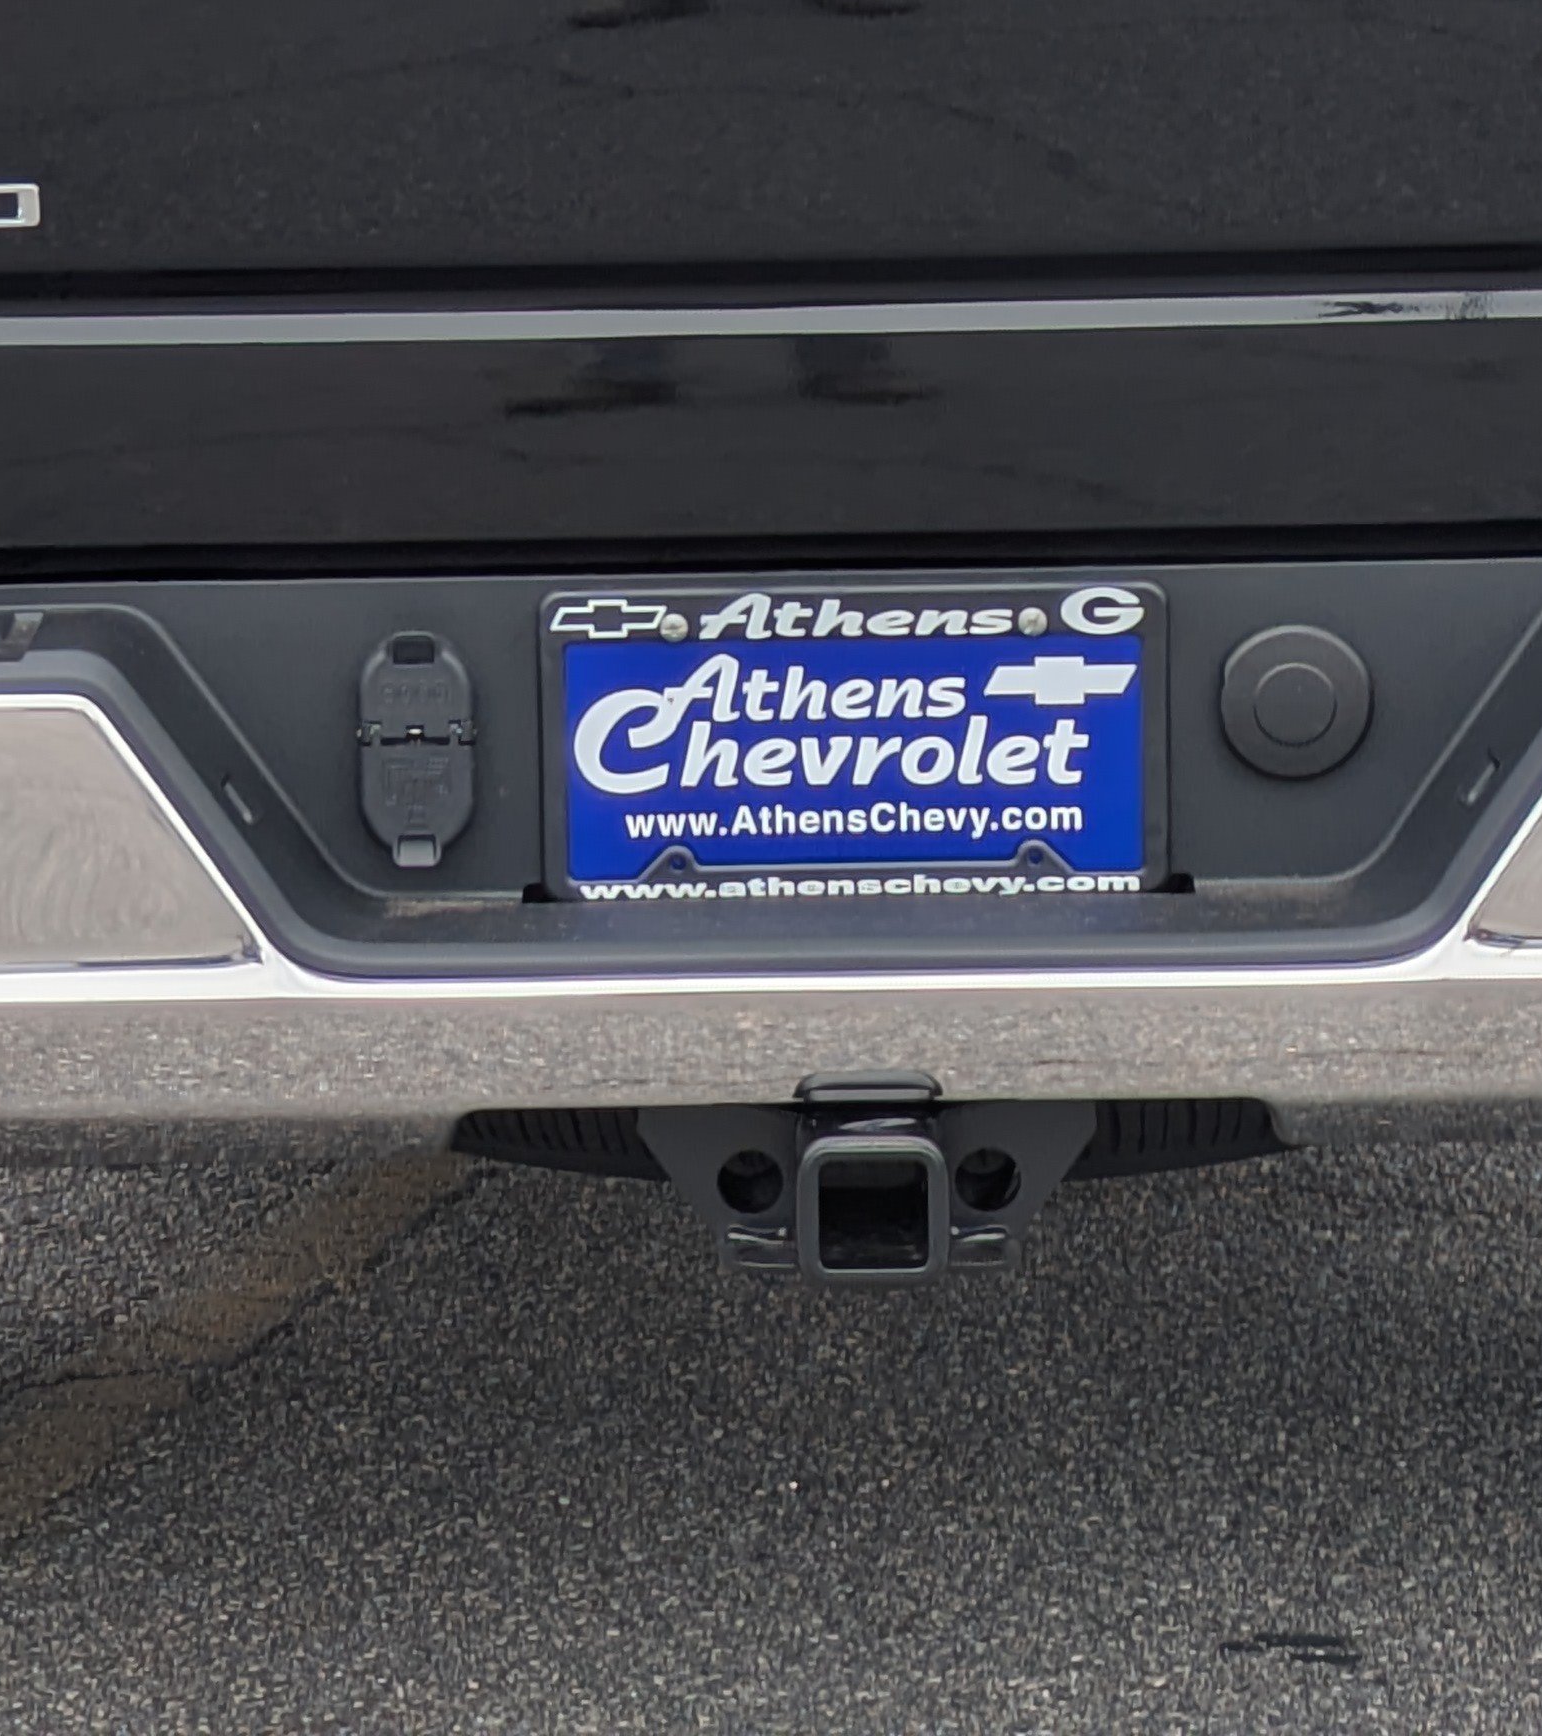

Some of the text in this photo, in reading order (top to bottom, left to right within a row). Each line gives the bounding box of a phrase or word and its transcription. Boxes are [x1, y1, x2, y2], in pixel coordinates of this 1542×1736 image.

[699, 586, 1145, 641] Athens G
[662, 653, 966, 722] Athens
[573, 688, 1089, 795] Chevrolet
[625, 802, 1084, 840] www.AthensChevy.com
[579, 872, 1141, 901] www.athenschevy.com
